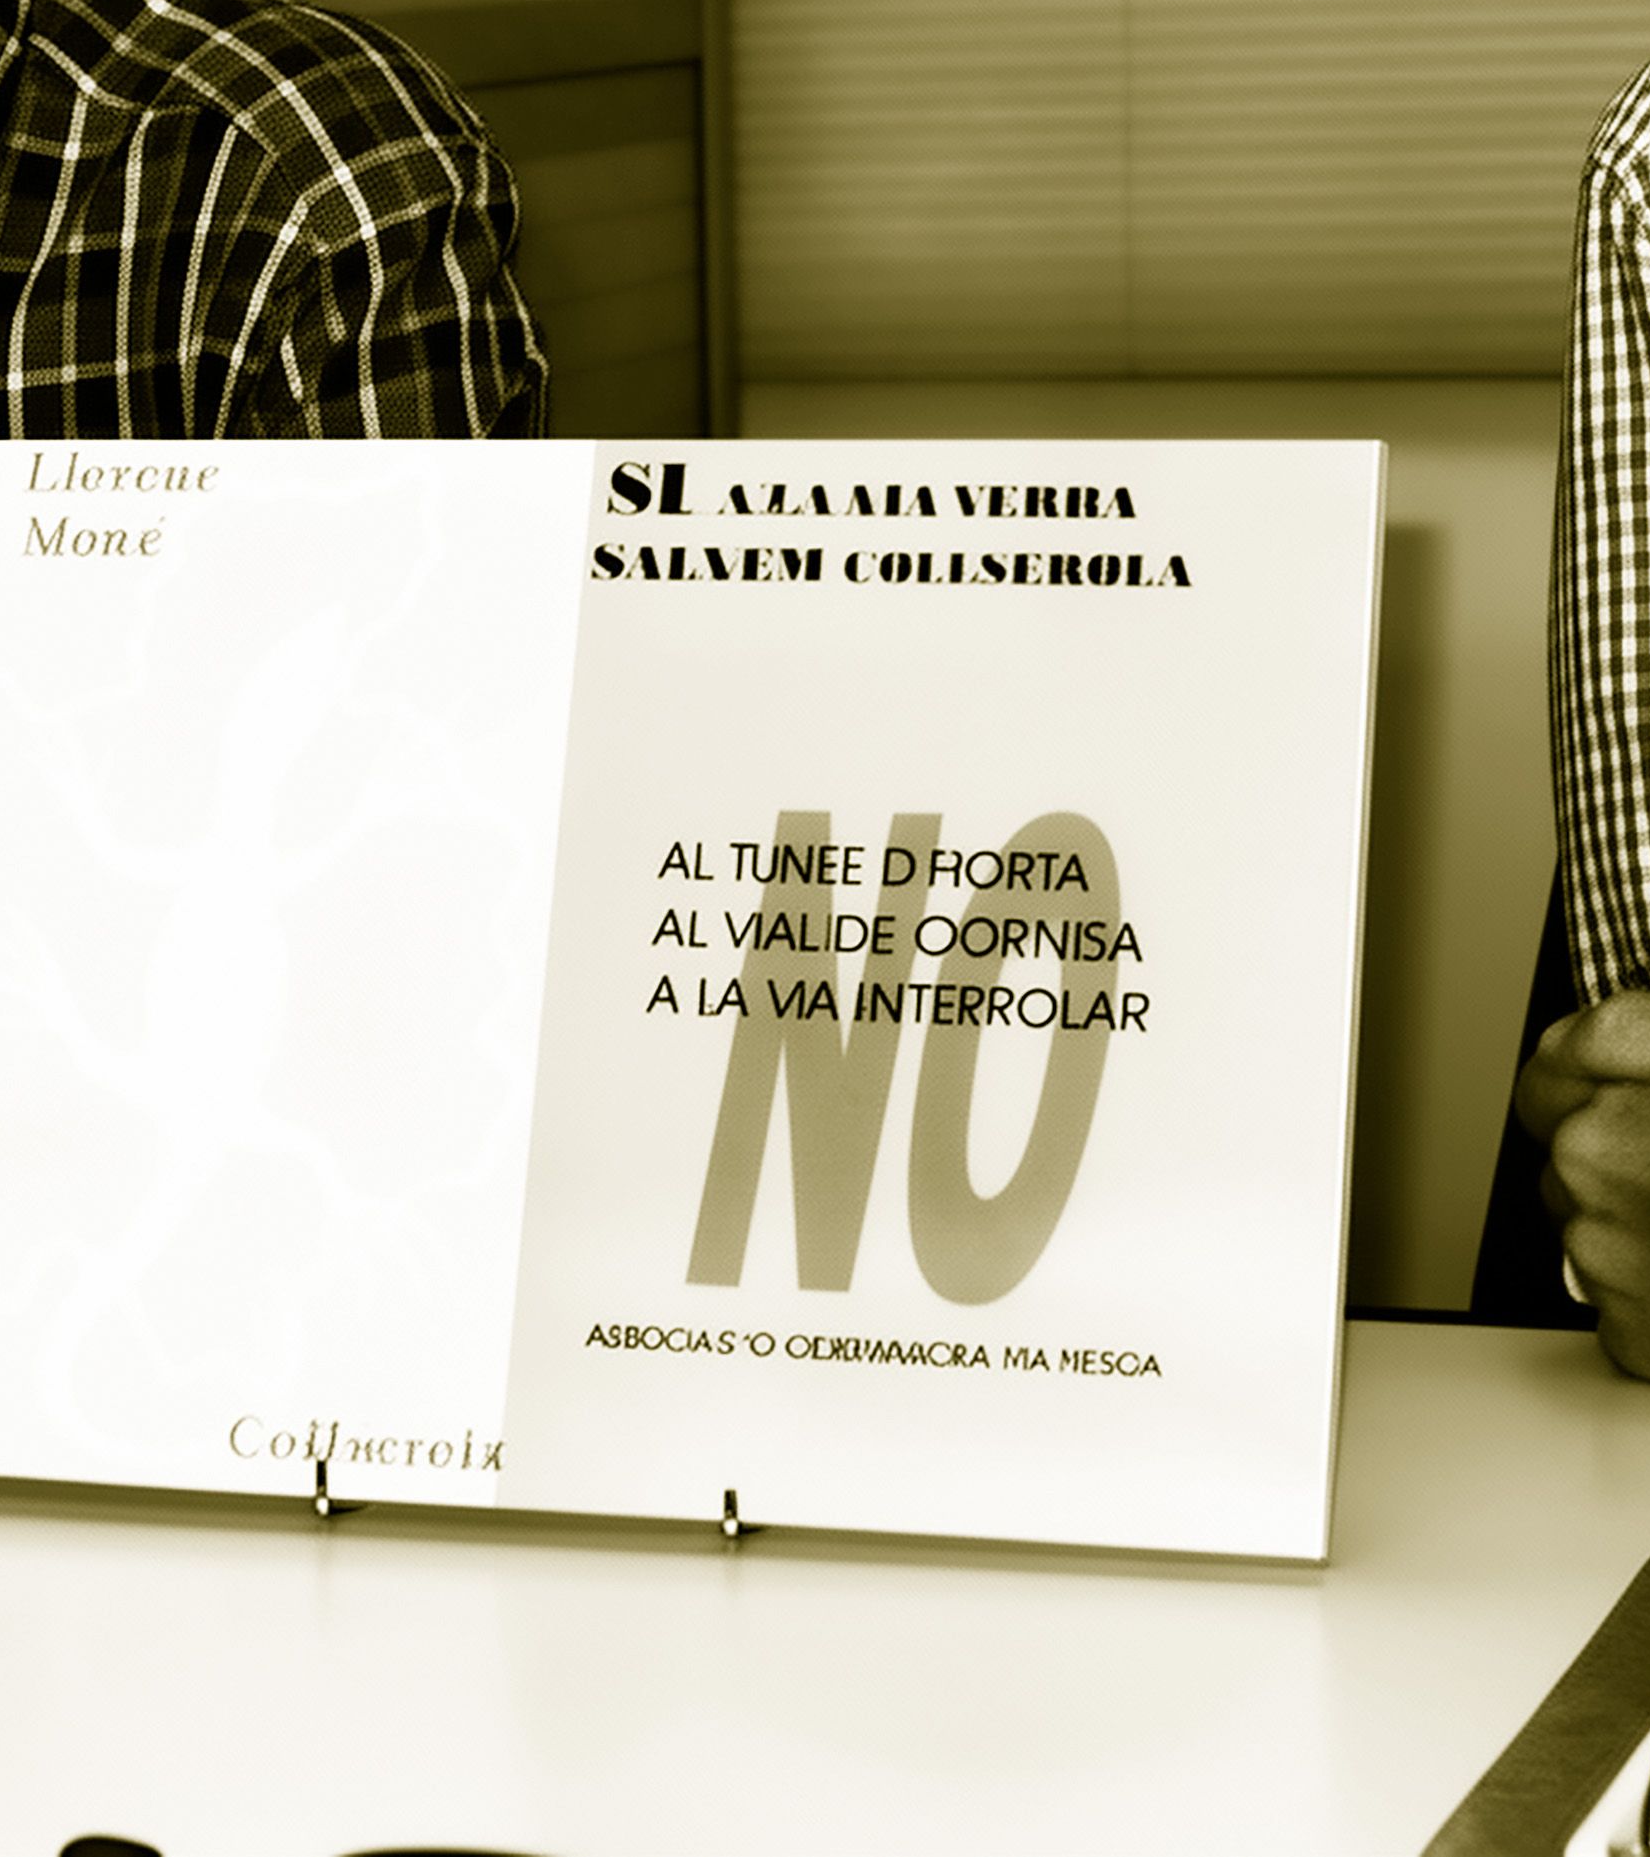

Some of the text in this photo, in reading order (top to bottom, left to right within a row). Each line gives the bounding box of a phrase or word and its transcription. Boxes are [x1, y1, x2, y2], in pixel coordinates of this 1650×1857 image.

[658, 842, 714, 880] AL
[652, 909, 707, 948] AL
[646, 976, 679, 1014] A
[698, 978, 749, 1017] LA
[685, 811, 1121, 1305] NO
